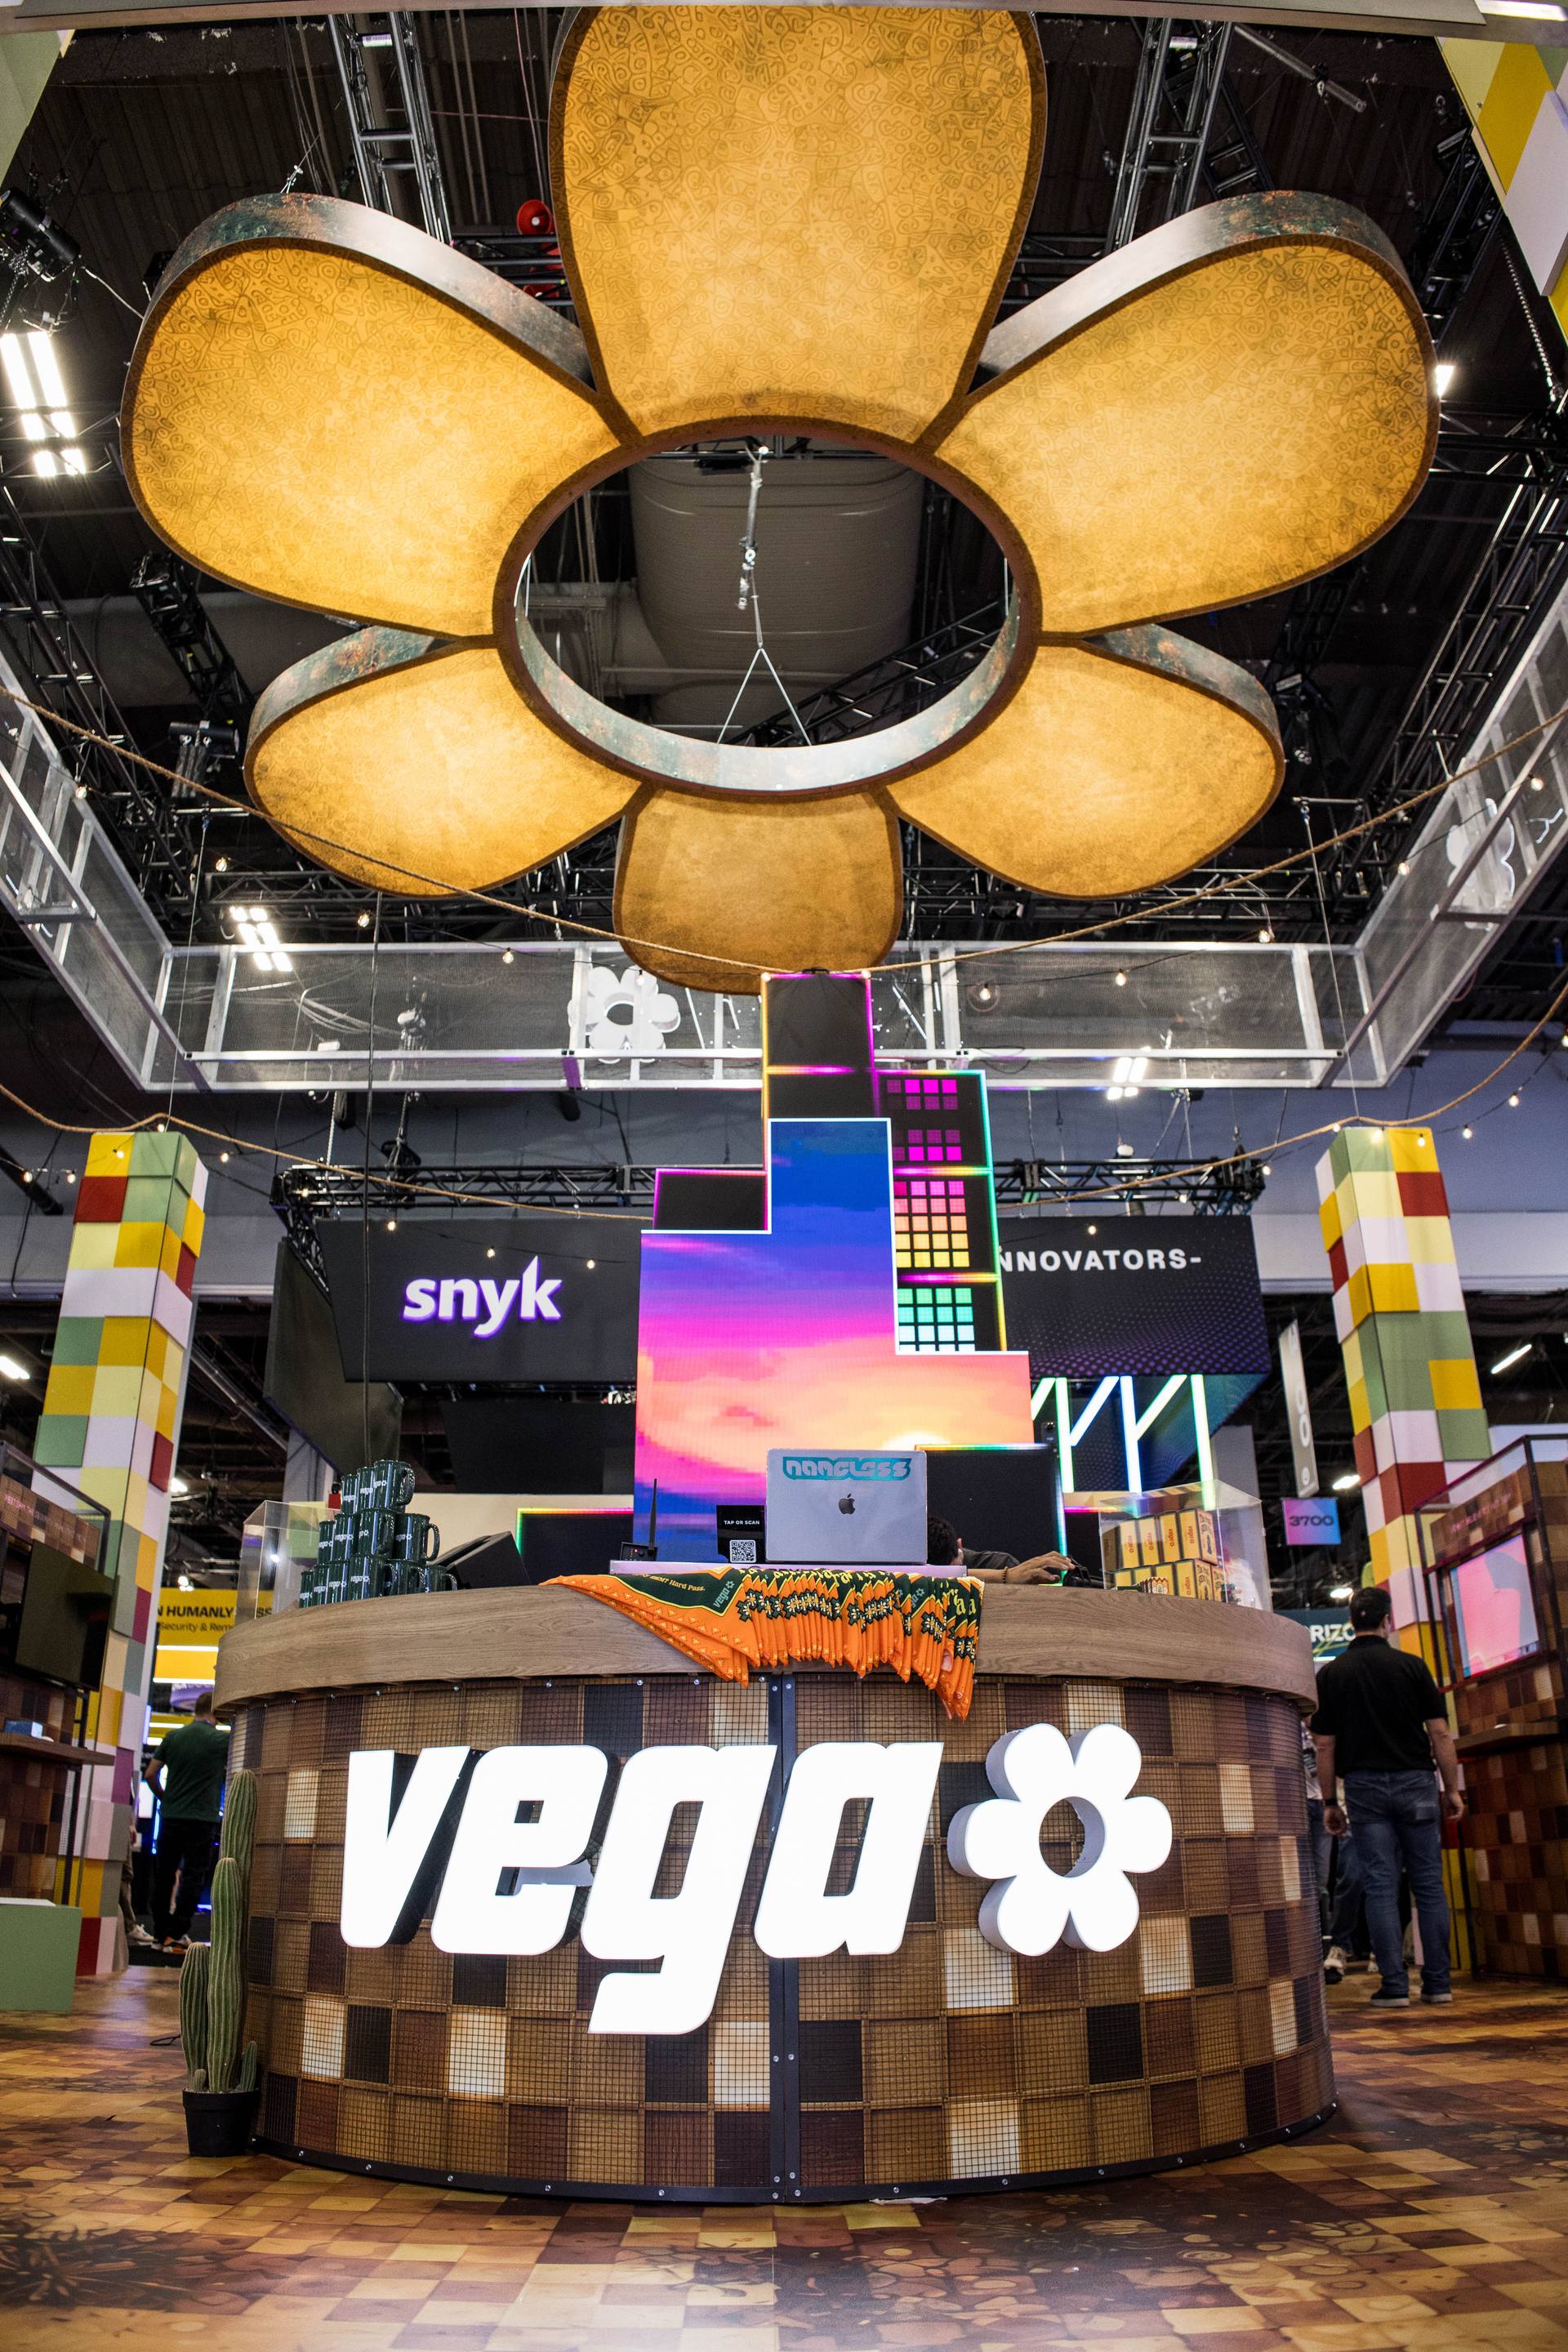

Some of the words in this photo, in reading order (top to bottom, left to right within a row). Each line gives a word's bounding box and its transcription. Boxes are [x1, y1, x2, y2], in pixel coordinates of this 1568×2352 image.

[403, 1255, 563, 1336] snyk
[1290, 1516, 1334, 1526] 3700
[669, 1579, 687, 1590] Hard
[713, 1588, 730, 1608] vega
[167, 1606, 235, 1618] HUMANLY
[199, 1623, 207, 1631] &
[340, 1741, 944, 2034] vega
